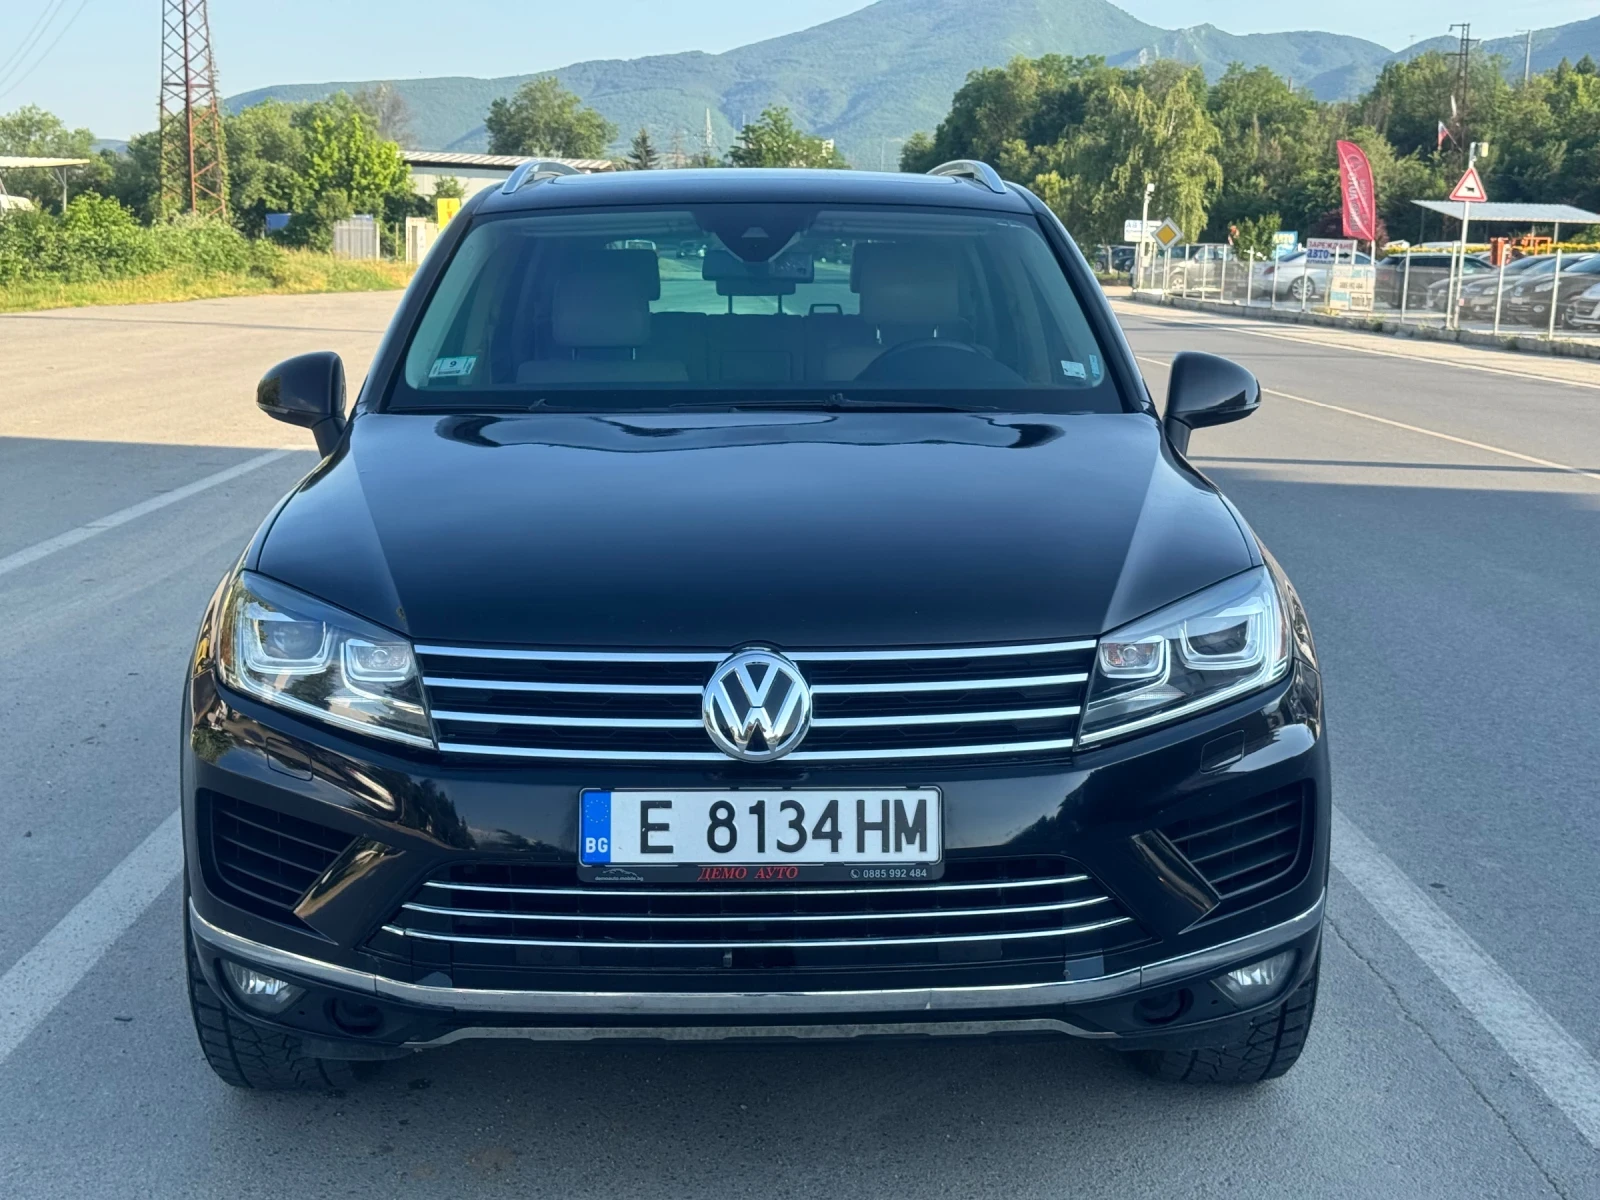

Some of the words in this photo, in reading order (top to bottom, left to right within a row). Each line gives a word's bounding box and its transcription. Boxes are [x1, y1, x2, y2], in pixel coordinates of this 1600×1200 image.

[640, 800, 674, 854] E
[585, 837, 608, 853] BG
[697, 867, 747, 881] ДЕМО
[754, 866, 798, 879] АУТО
[863, 869, 886, 878] 0885
[889, 868, 907, 878] 992
[909, 868, 927, 877] 484
